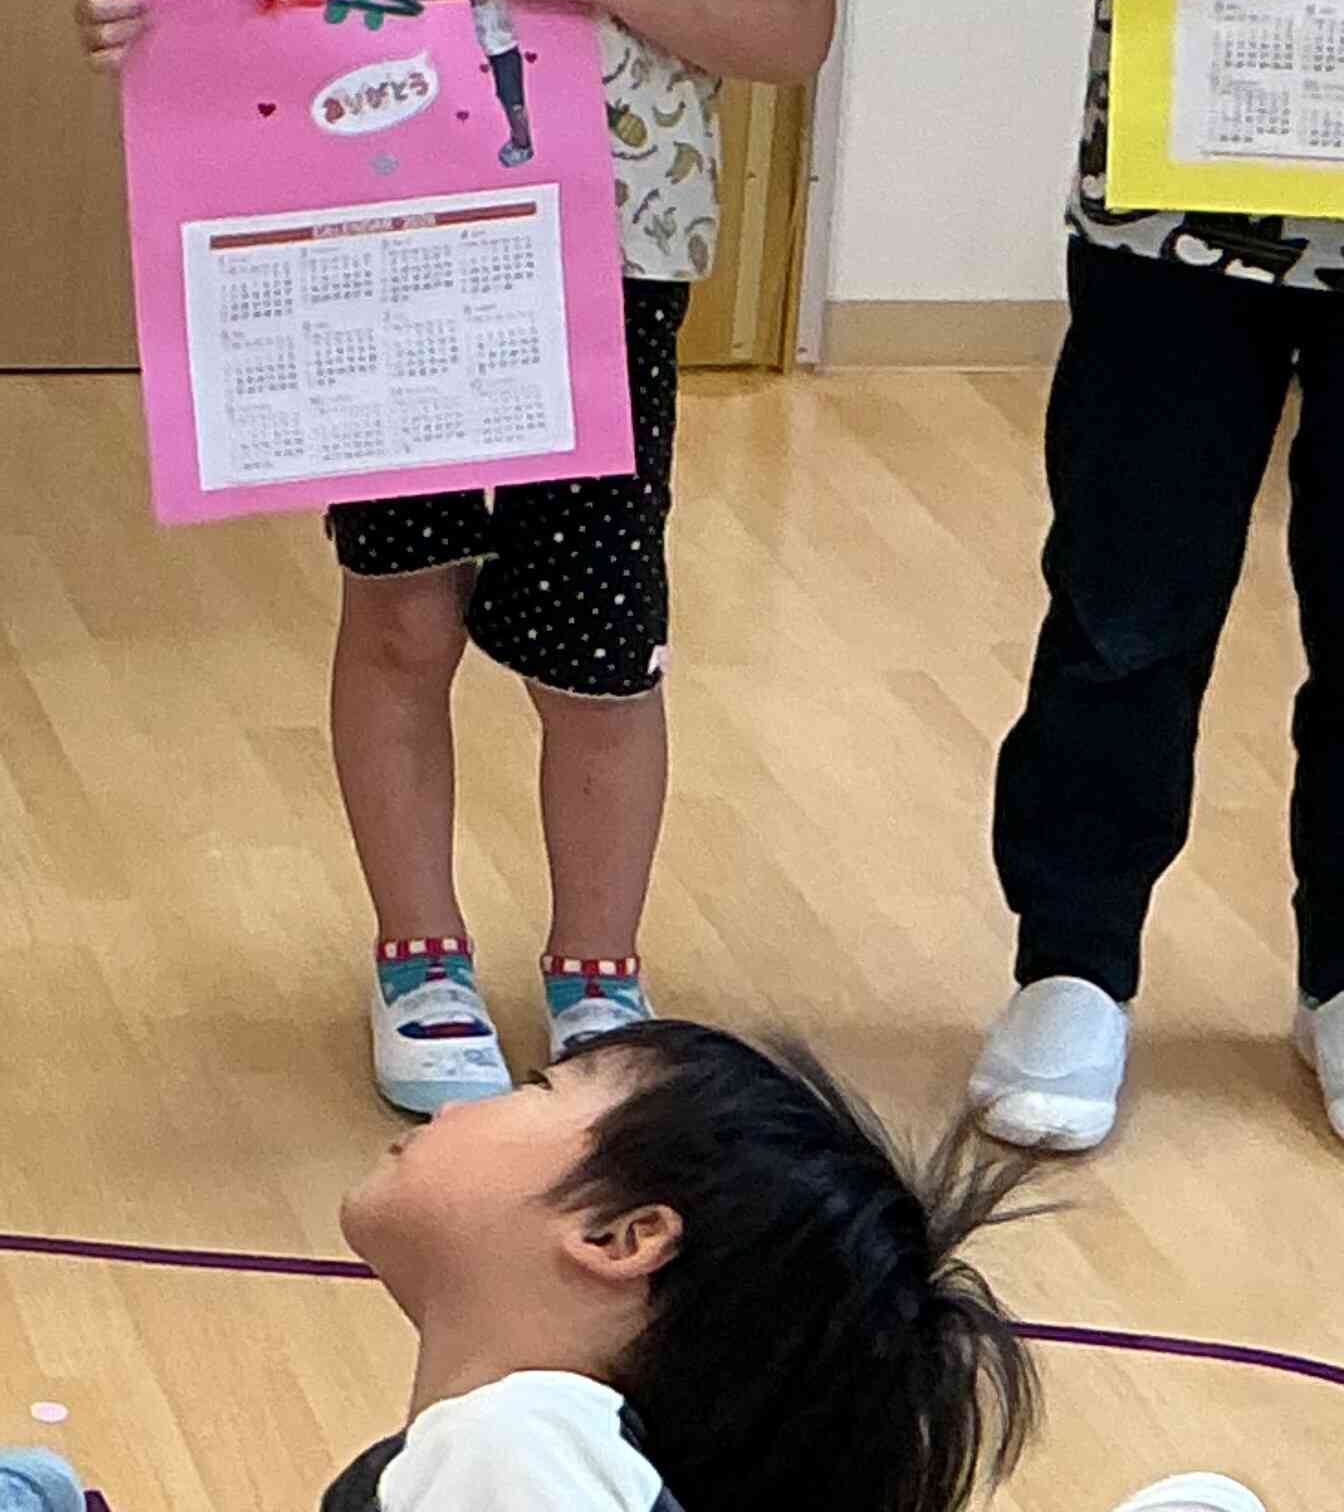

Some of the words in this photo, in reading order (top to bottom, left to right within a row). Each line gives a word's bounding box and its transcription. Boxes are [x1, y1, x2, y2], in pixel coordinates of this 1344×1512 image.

[322, 72, 429, 124] ありがとう
